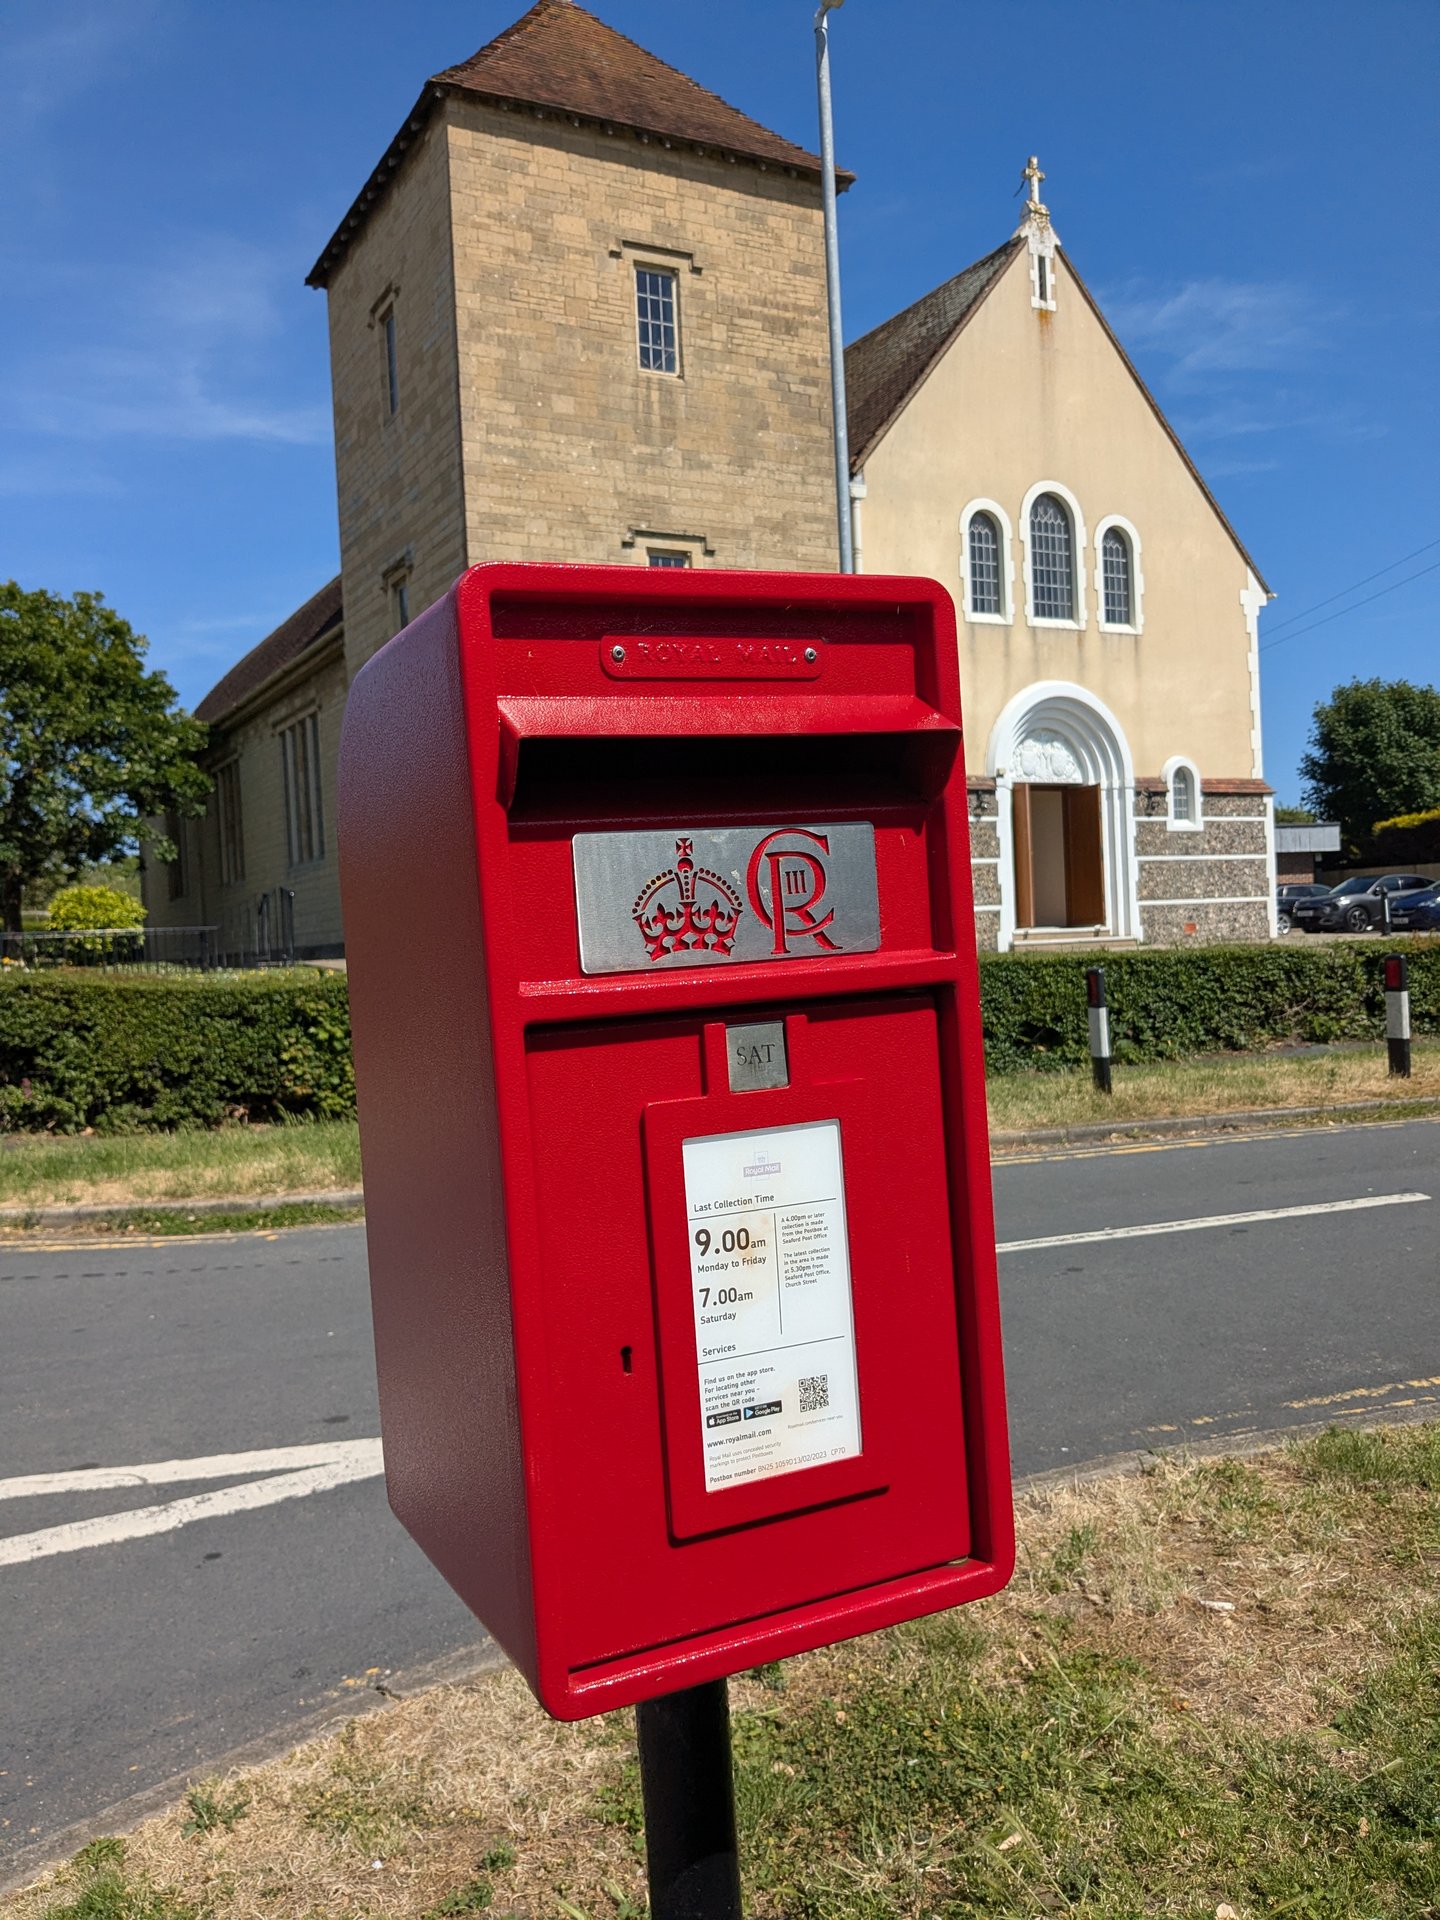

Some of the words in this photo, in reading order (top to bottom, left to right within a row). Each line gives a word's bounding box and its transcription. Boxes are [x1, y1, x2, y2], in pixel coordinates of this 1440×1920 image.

[637, 642, 721, 662] ROYAL
[736, 643, 798, 663] MAIL
[736, 1043, 775, 1067] SAT
[745, 1165, 764, 1176] Royal
[764, 1164, 779, 1173] Mail
[694, 1203, 711, 1212] Last
[714, 1197, 753, 1209] Collection
[754, 1194, 775, 1203] Time
[782, 1222, 804, 1230] collection
[782, 1236, 801, 1244] Seaford
[697, 1261, 729, 1273] Monday
[731, 1260, 740, 1268] to
[742, 1255, 767, 1266] Friday
[790, 1265, 812, 1273] 5.30pm
[784, 1273, 803, 1281] Seaford
[700, 1311, 737, 1325] Saturday
[702, 1344, 737, 1357] Services
[704, 1377, 716, 1385] Find
[716, 1382, 738, 1392] locating
[705, 1393, 728, 1403] services
[754, 1407, 770, 1416] Google
[707, 1429, 772, 1448] www.royalmail.com
[764, 1441, 782, 1450] security
[710, 1460, 730, 1469] markings
[736, 1455, 752, 1464] protect
[752, 1450, 774, 1459] Postboxes
[710, 1474, 733, 1484] Postbox
[734, 1468, 756, 1478] number
[758, 1462, 774, 1472] BN25
